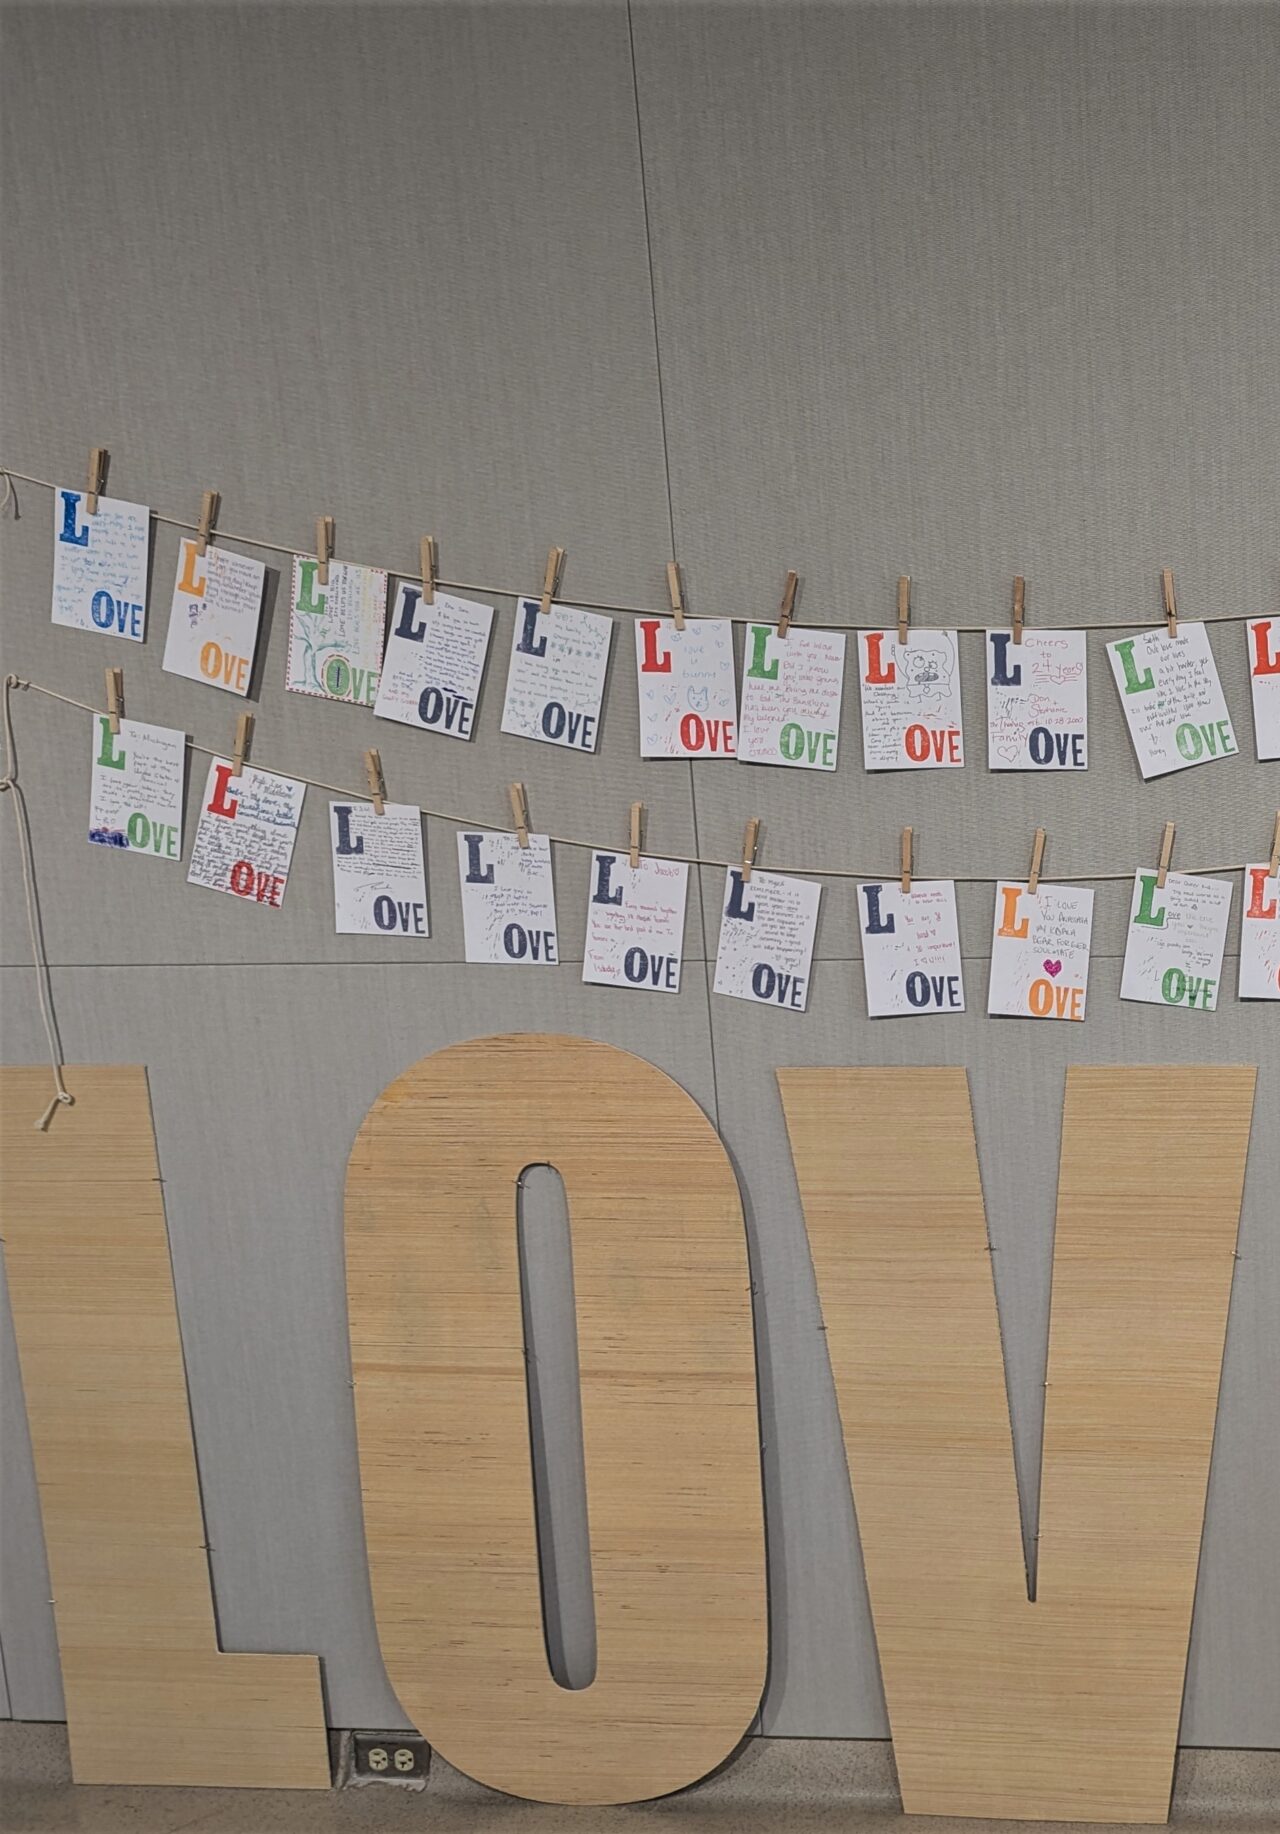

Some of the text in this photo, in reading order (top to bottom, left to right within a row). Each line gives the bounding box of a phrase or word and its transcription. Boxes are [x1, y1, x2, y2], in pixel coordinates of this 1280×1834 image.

[60, 491, 90, 547] L
[296, 560, 326, 615] L
[91, 590, 144, 638] OVE
[394, 586, 427, 643] L
[516, 602, 548, 658] L
[200, 641, 249, 691] OVE
[640, 620, 671, 672] L
[747, 626, 780, 680] L
[864, 632, 896, 684] L
[990, 632, 1022, 686] L
[1025, 638, 1068, 648] Cheers
[1032, 659, 1051, 674] 24
[1114, 639, 1156, 694] L
[418, 686, 474, 735] OVE
[542, 702, 596, 748] OVE
[680, 713, 736, 753] OVE
[780, 722, 836, 766] OVE
[904, 724, 962, 763] OVE
[1028, 726, 1085, 767] OVE
[1175, 719, 1237, 761] OVE
[207, 764, 238, 819] L
[126, 812, 179, 857] OVE
[333, 806, 364, 855] L
[464, 834, 494, 884] L
[592, 855, 624, 906] L
[374, 895, 426, 934] OVE
[862, 885, 895, 934] L
[997, 887, 1029, 938] L
[1045, 896, 1078, 910] I LOVE
[1134, 876, 1166, 926] L
[1246, 868, 1277, 920] L
[503, 922, 557, 962] OVE
[624, 946, 678, 988] OVE
[752, 962, 805, 1008] OVE
[905, 971, 962, 1008] OVE
[1161, 967, 1217, 1010] OVE
[1028, 978, 1084, 1020] OVE
